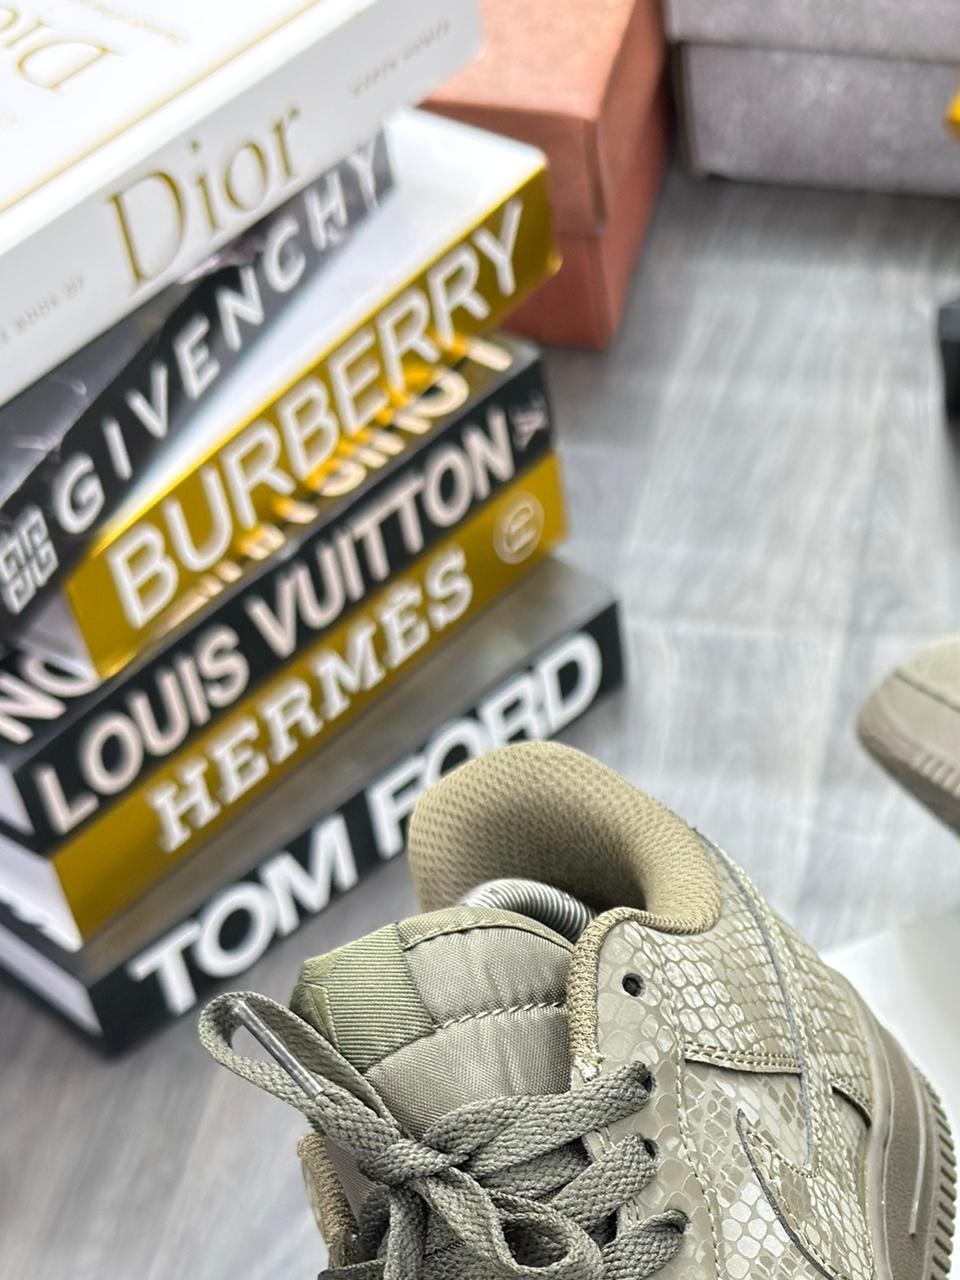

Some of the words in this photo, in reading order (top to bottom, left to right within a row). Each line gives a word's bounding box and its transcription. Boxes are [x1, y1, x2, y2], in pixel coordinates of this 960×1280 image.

[54, 138, 378, 534] GIVENCHY
[105, 105, 302, 288] Dior
[108, 200, 523, 629] BURBERRY
[42, 624, 249, 833] LOUIS
[249, 406, 515, 657] VUITTON
[129, 814, 357, 1016] TOM
